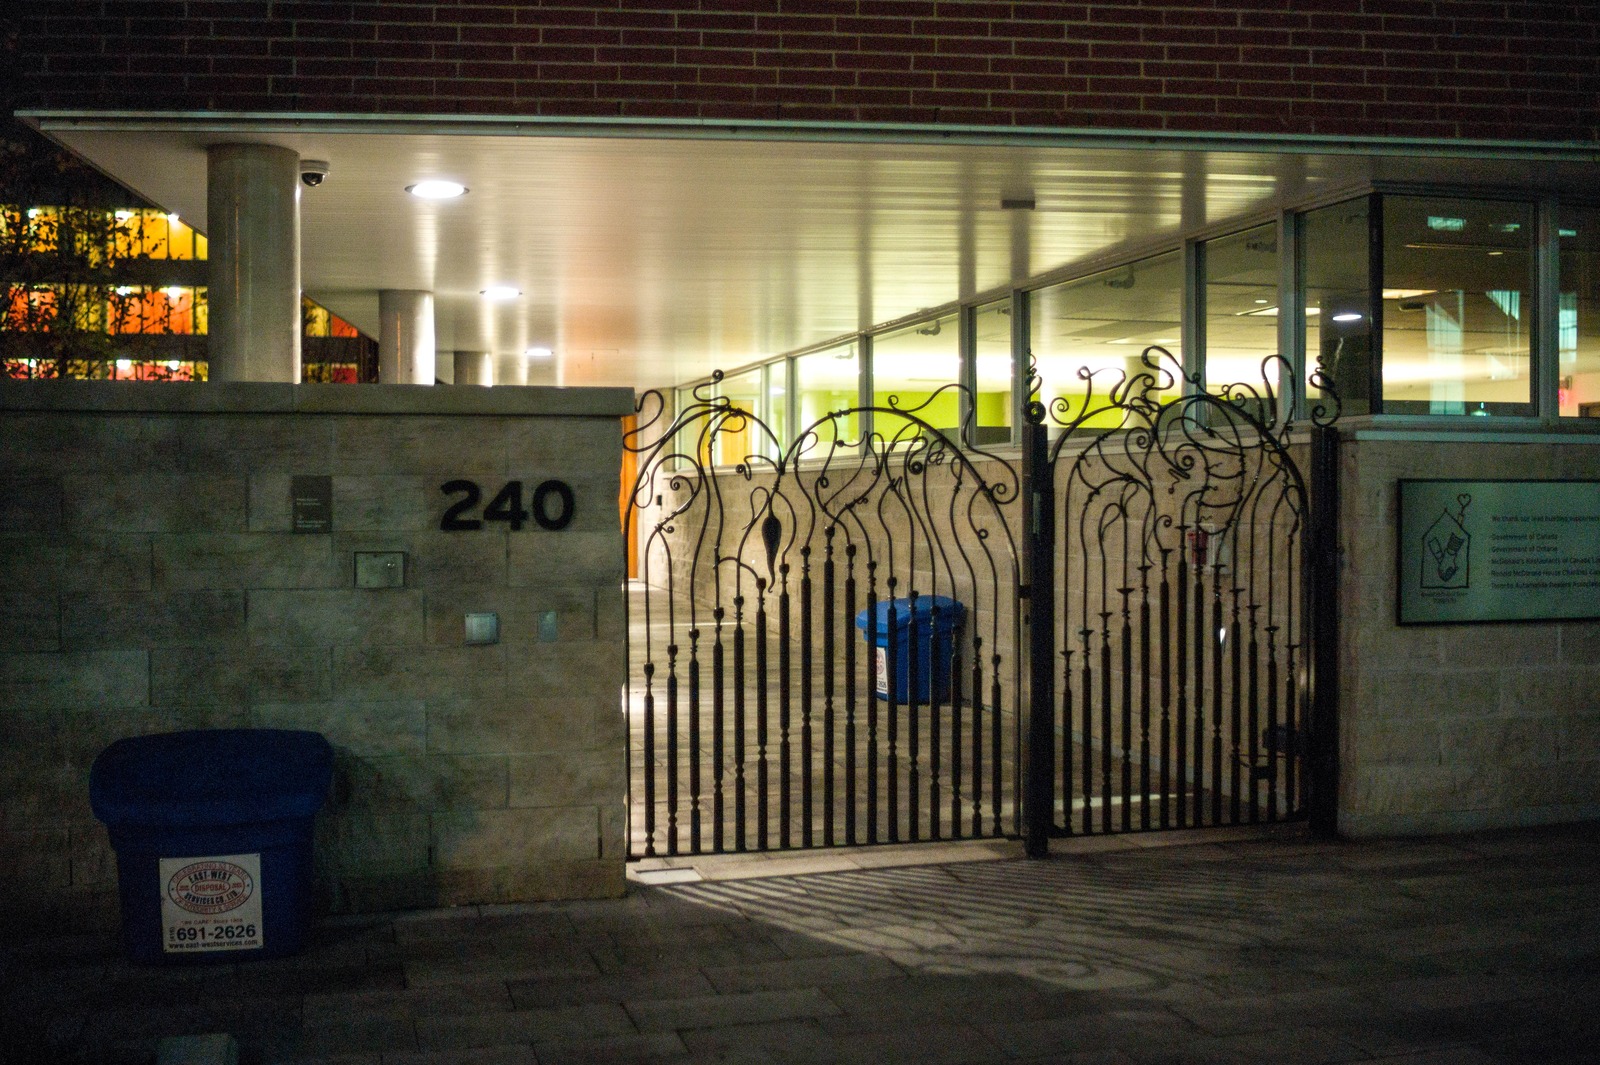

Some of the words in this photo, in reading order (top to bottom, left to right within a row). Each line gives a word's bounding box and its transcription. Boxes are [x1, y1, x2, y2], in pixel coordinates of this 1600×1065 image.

[440, 479, 574, 531] 240
[194, 884, 226, 892] DISPOSAL
[176, 924, 256, 941] 691-2626
